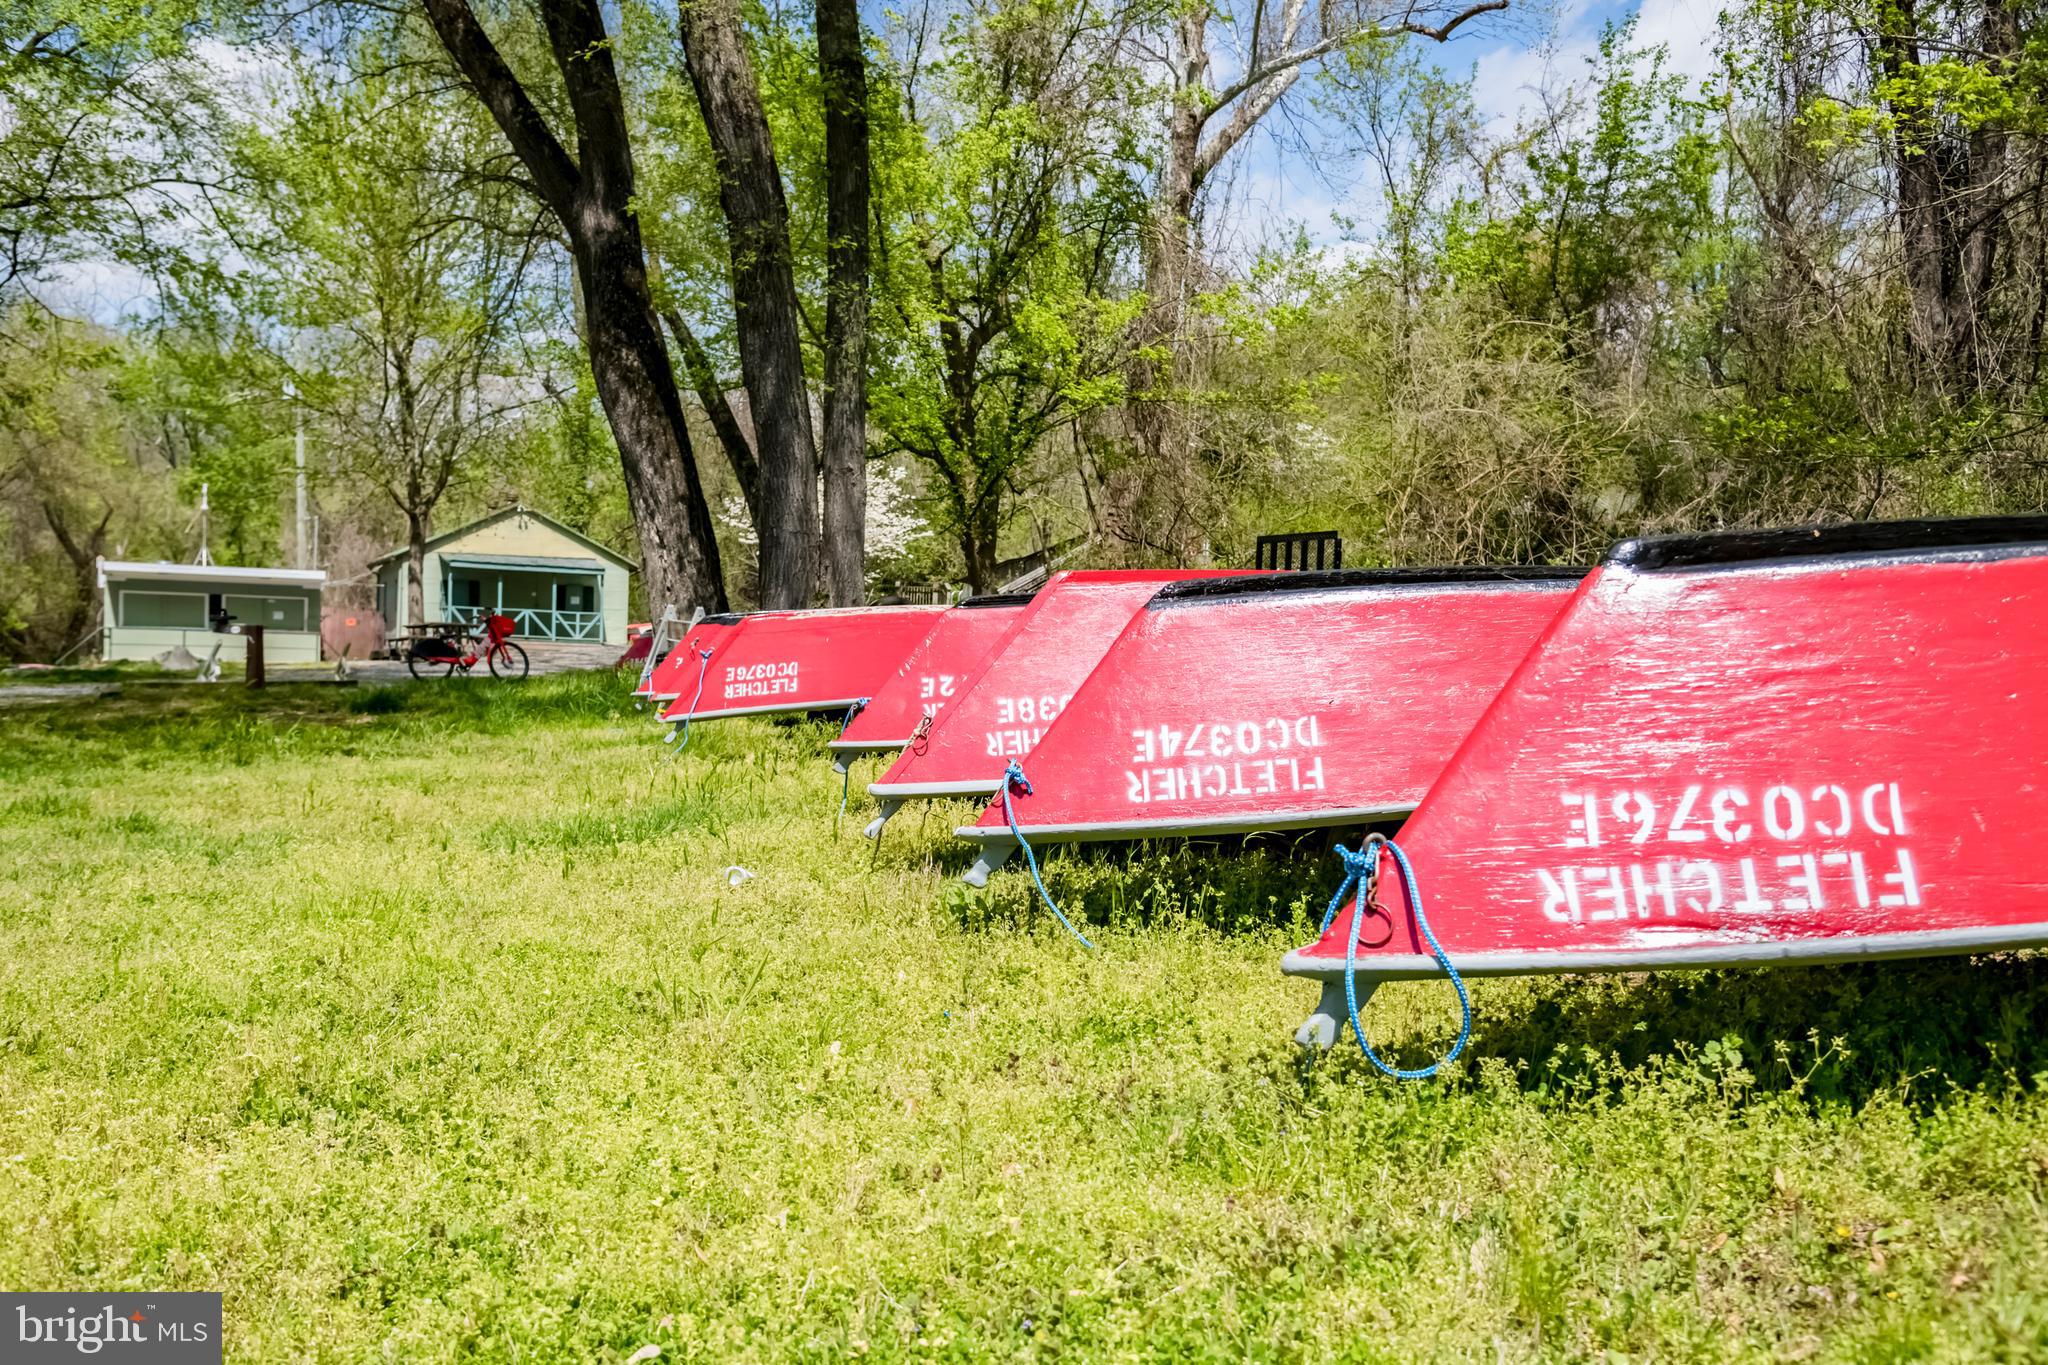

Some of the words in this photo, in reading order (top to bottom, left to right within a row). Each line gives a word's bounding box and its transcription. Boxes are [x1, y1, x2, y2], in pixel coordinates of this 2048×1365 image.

[724, 677, 798, 699] FLETCHER
[726, 661, 798, 682] DC0376E
[986, 727, 1050, 756] HER
[1132, 715, 1325, 762] DC0374E
[1125, 757, 1325, 803] FLETCHER
[1562, 782, 1907, 847] DC0376E
[1537, 848, 1920, 923] FLETCHER
